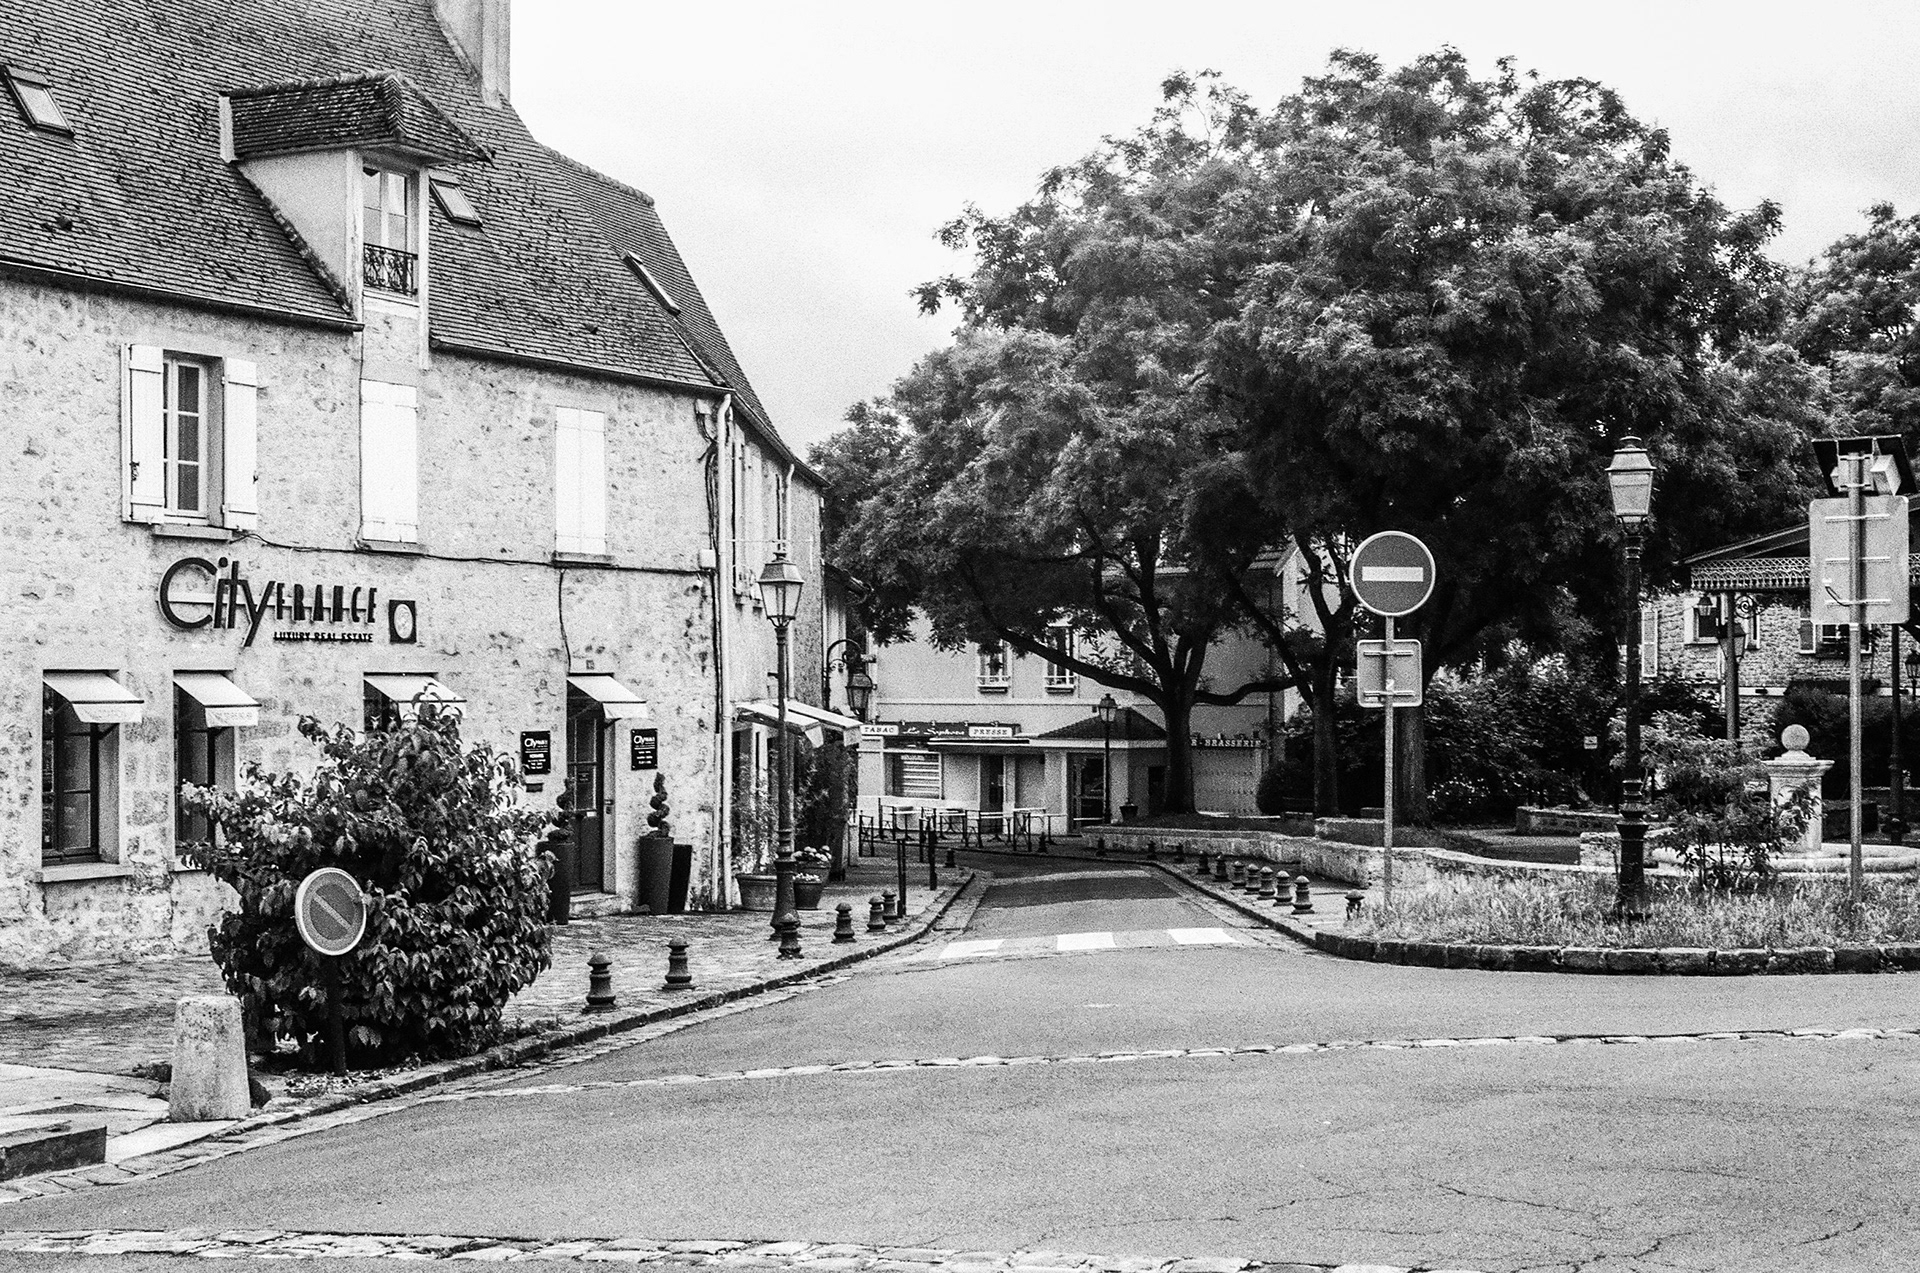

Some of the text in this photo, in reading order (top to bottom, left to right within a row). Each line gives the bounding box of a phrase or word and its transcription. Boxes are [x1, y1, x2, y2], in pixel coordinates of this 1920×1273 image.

[159, 556, 378, 647] City FRANCE
[273, 631, 373, 643] LUXURY REAL ESTATE
